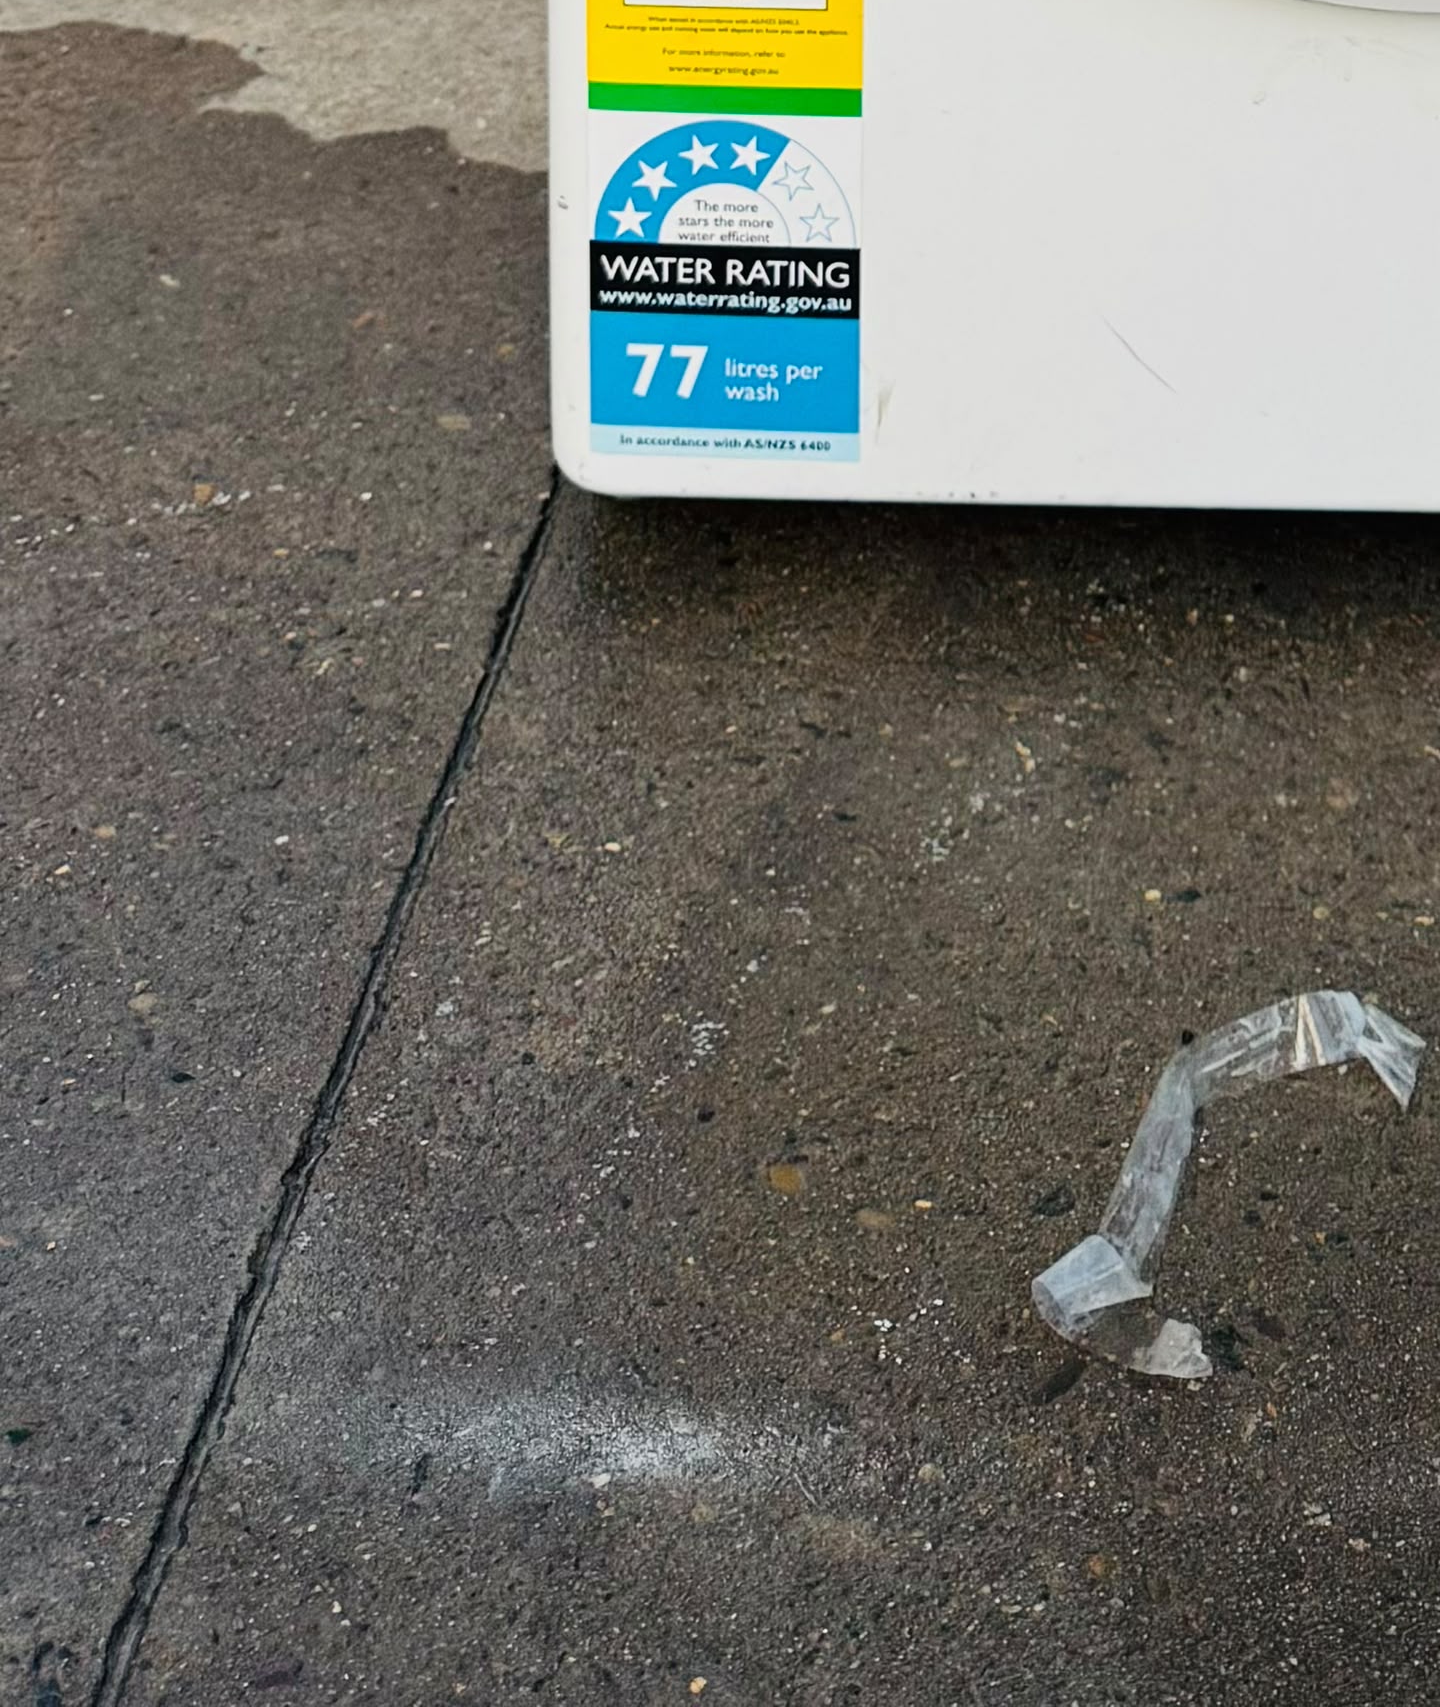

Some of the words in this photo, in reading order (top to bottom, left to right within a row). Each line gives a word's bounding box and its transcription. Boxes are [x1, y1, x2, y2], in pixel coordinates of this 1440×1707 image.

[694, 199, 722, 213] The
[724, 202, 758, 213] more
[678, 215, 709, 227] stars
[714, 215, 735, 228] the
[738, 217, 774, 229] more
[678, 231, 714, 243] water
[719, 230, 770, 244] efficient
[599, 254, 716, 285] WATER
[725, 258, 850, 289] RATING
[599, 289, 852, 314] www.waterrating.gov.au
[625, 343, 709, 399] 77
[725, 358, 779, 379] litres
[785, 363, 823, 384] per
[724, 382, 780, 402] wash
[620, 434, 633, 445] In
[636, 436, 709, 448] accordance
[714, 438, 741, 448] with
[743, 439, 796, 450] AS/NZS
[800, 440, 831, 451] 6400
